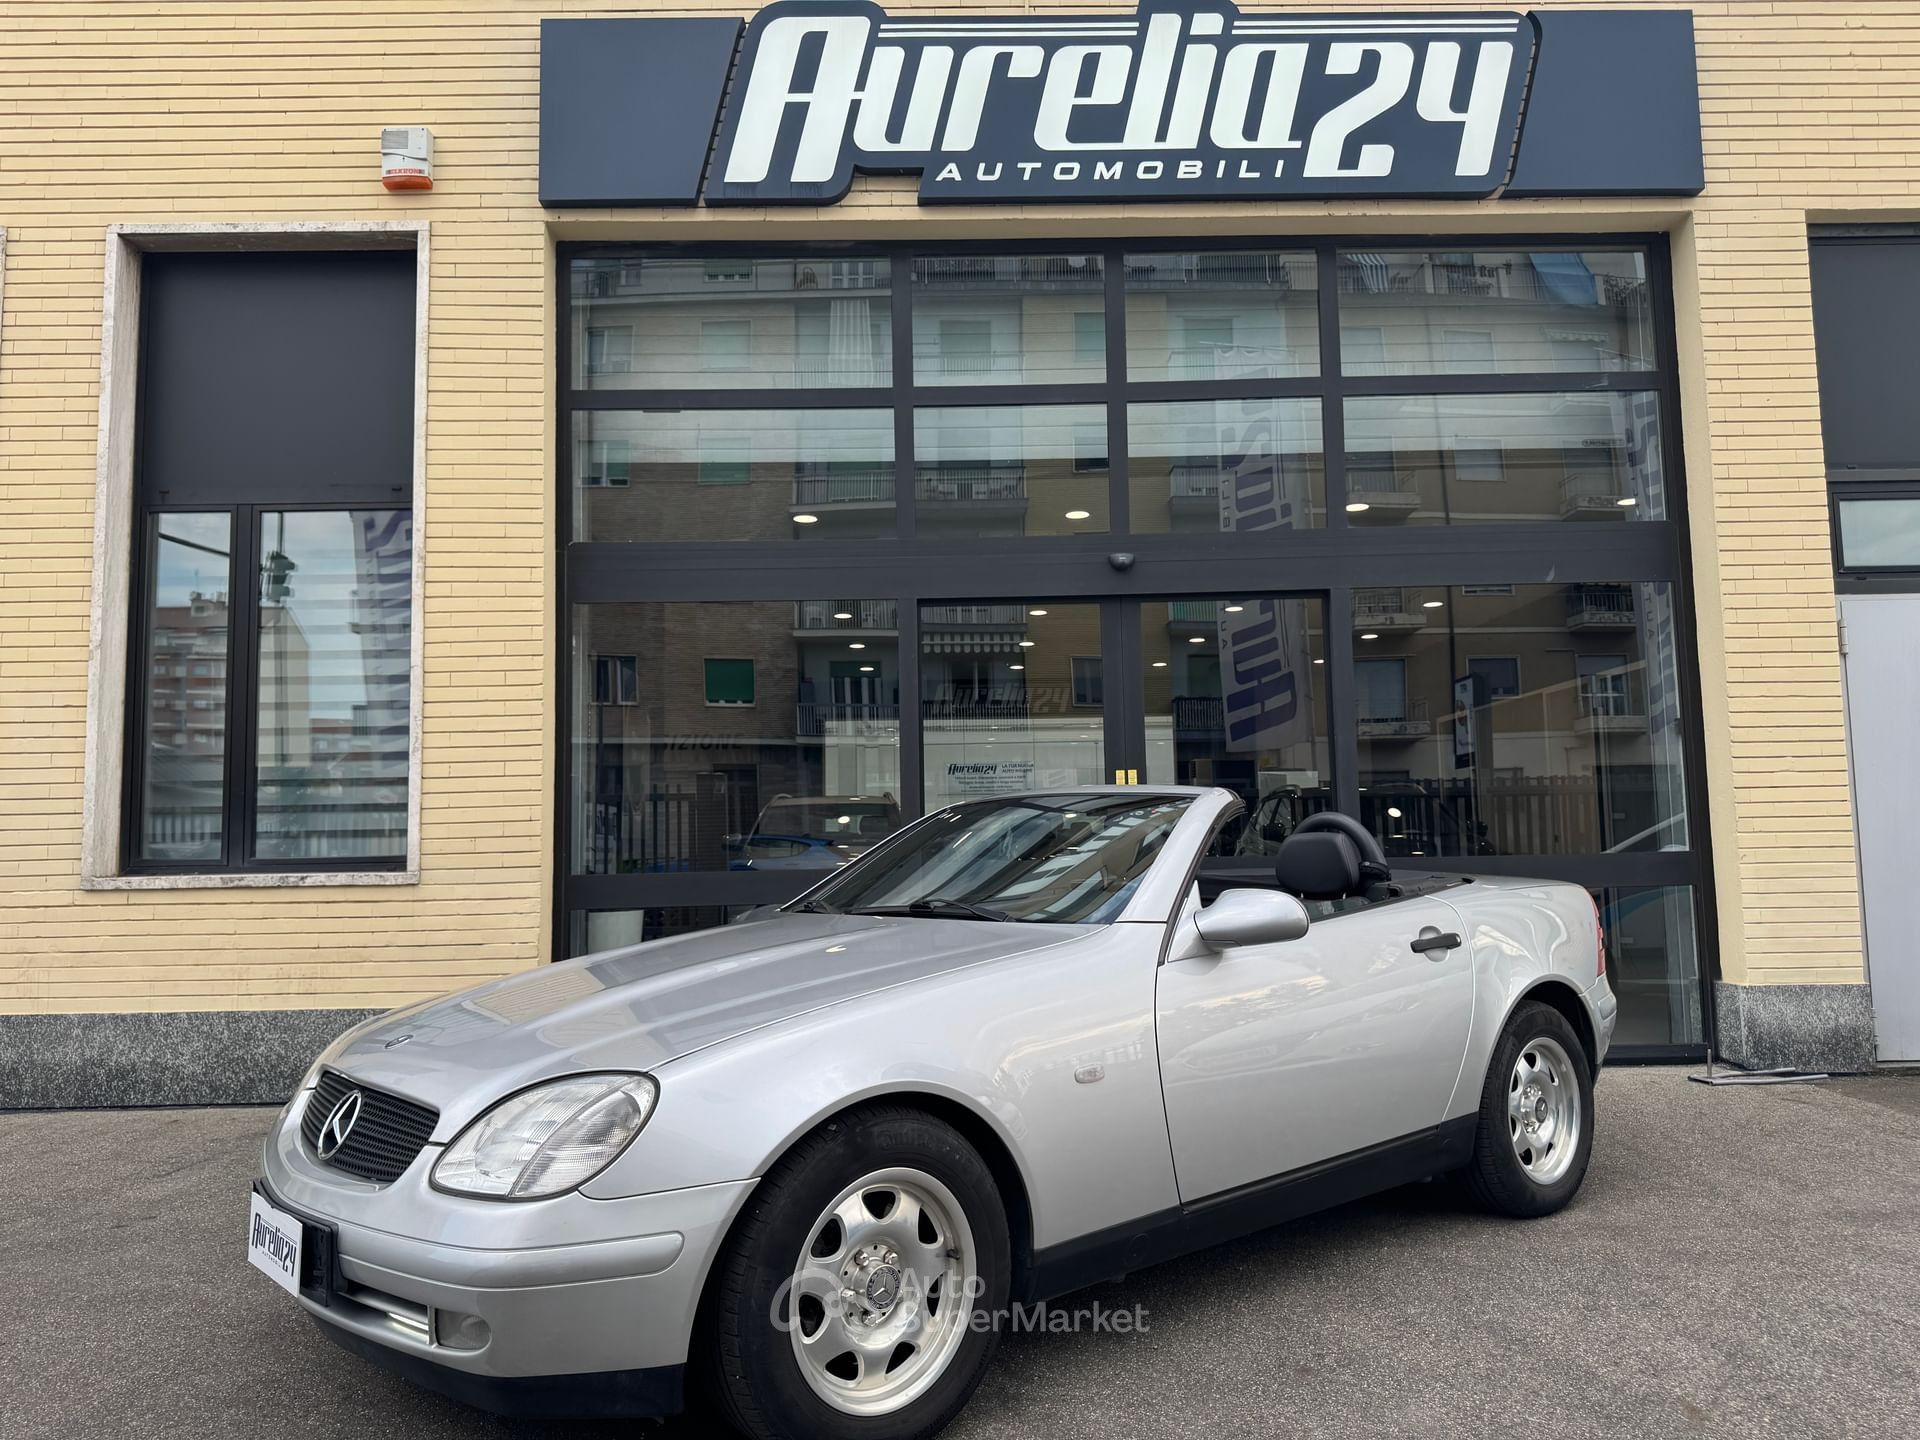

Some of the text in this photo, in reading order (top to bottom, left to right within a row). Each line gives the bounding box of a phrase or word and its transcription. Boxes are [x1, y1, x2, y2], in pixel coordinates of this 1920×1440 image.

[723, 13, 1514, 183] Aurelia24
[935, 160, 1284, 181] AUTOMOBILI
[947, 763, 998, 775] Aurelia24
[251, 1212, 297, 1277] Aurelia24
